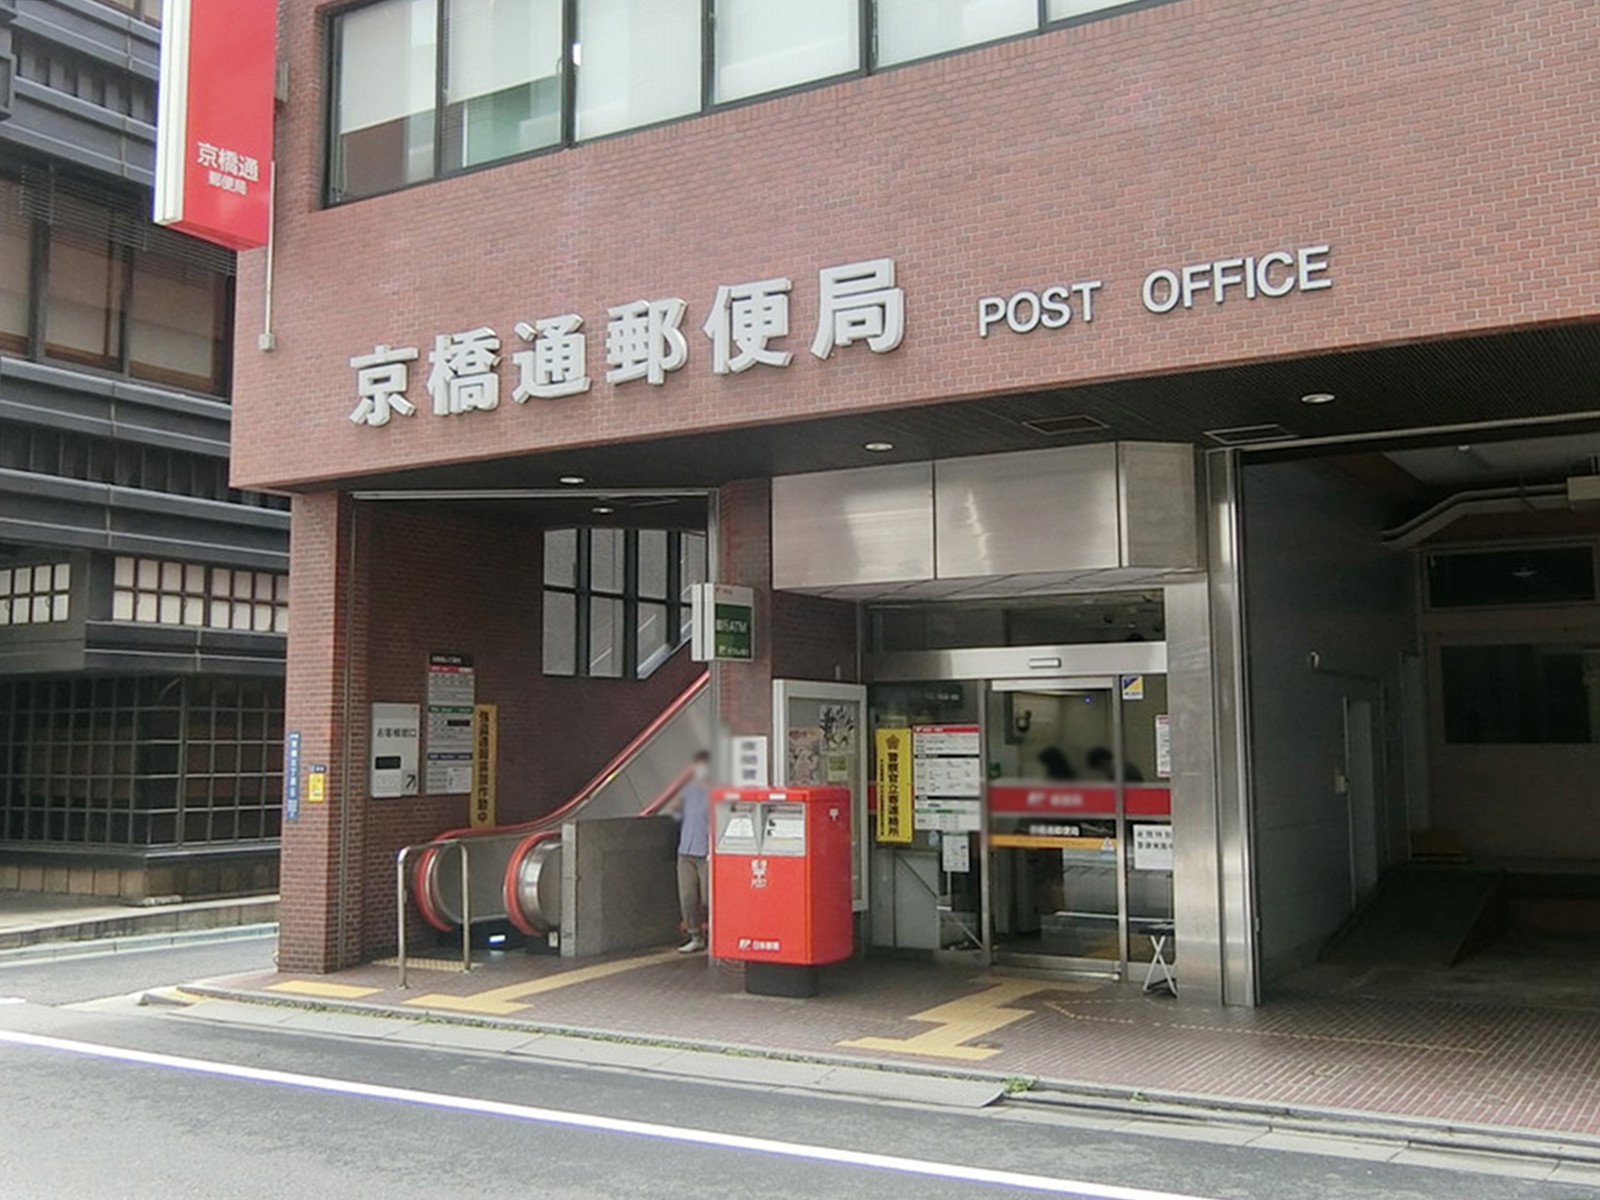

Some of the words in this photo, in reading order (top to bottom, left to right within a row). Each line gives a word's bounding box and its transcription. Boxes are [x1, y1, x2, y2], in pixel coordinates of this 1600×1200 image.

[197, 142, 259, 182] 京橋通
[208, 170, 247, 195] 郵便局
[978, 280, 1103, 338] POST
[1142, 245, 1332, 315] OFFICE
[350, 256, 906, 427] 京橋通郵便局
